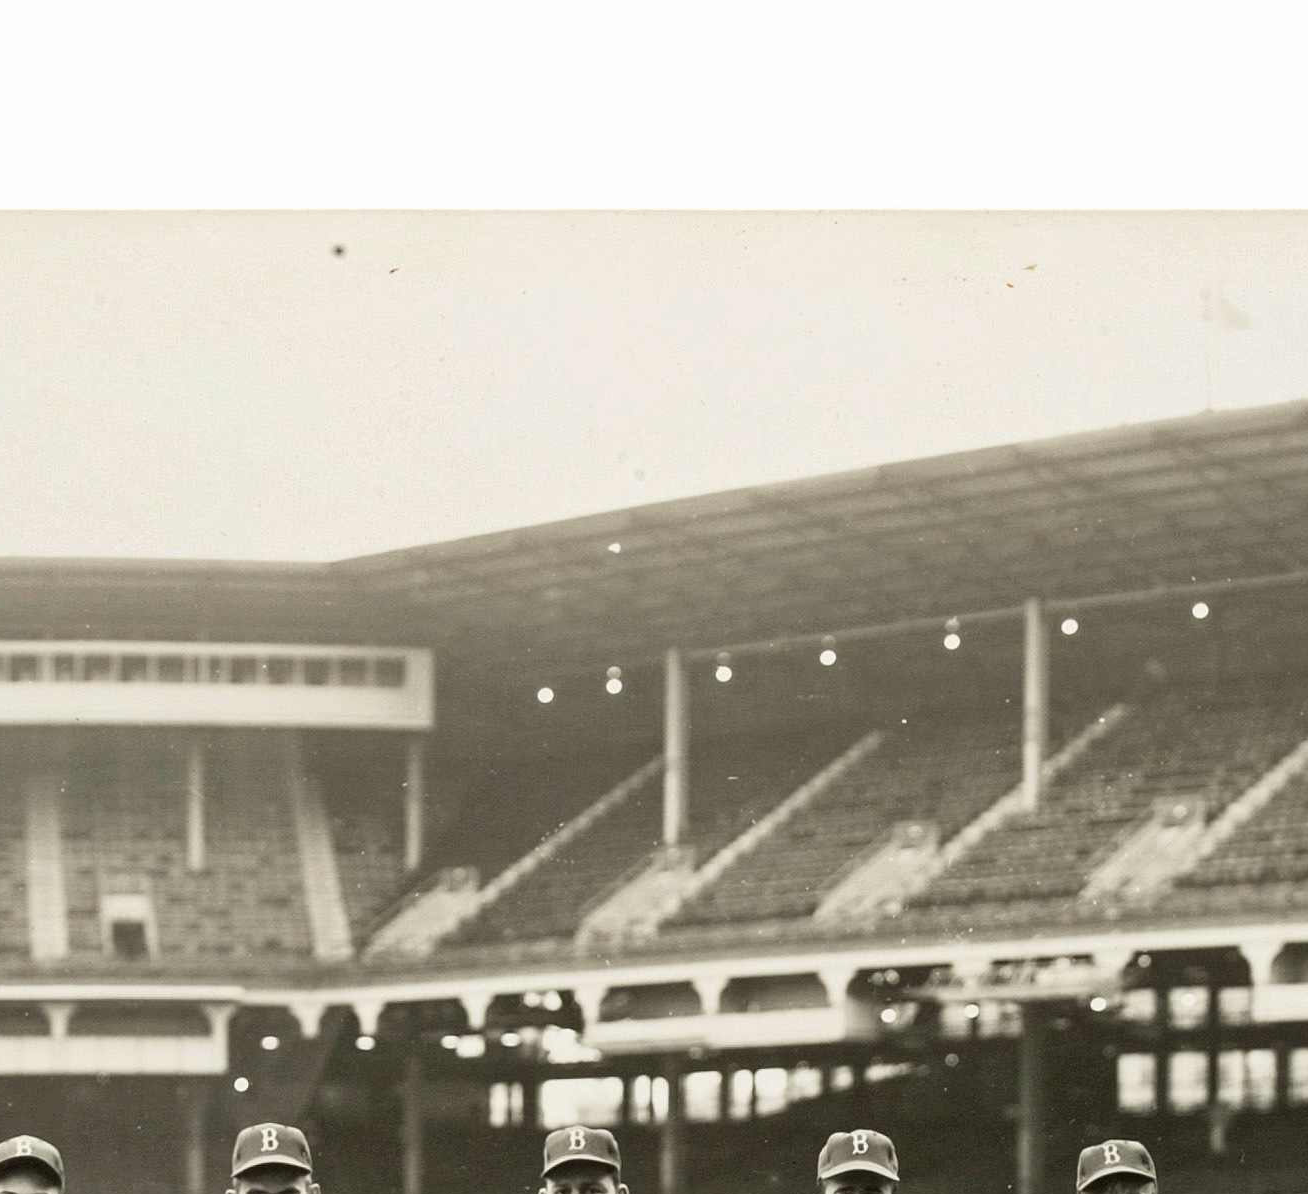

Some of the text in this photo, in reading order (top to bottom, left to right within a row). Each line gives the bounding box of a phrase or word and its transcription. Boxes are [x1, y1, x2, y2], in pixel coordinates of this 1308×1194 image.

[14, 1139, 33, 1156] B
[260, 1127, 279, 1151] B
[567, 1129, 584, 1151] B
[852, 1132, 869, 1155] B
[1103, 1142, 1121, 1165] B
